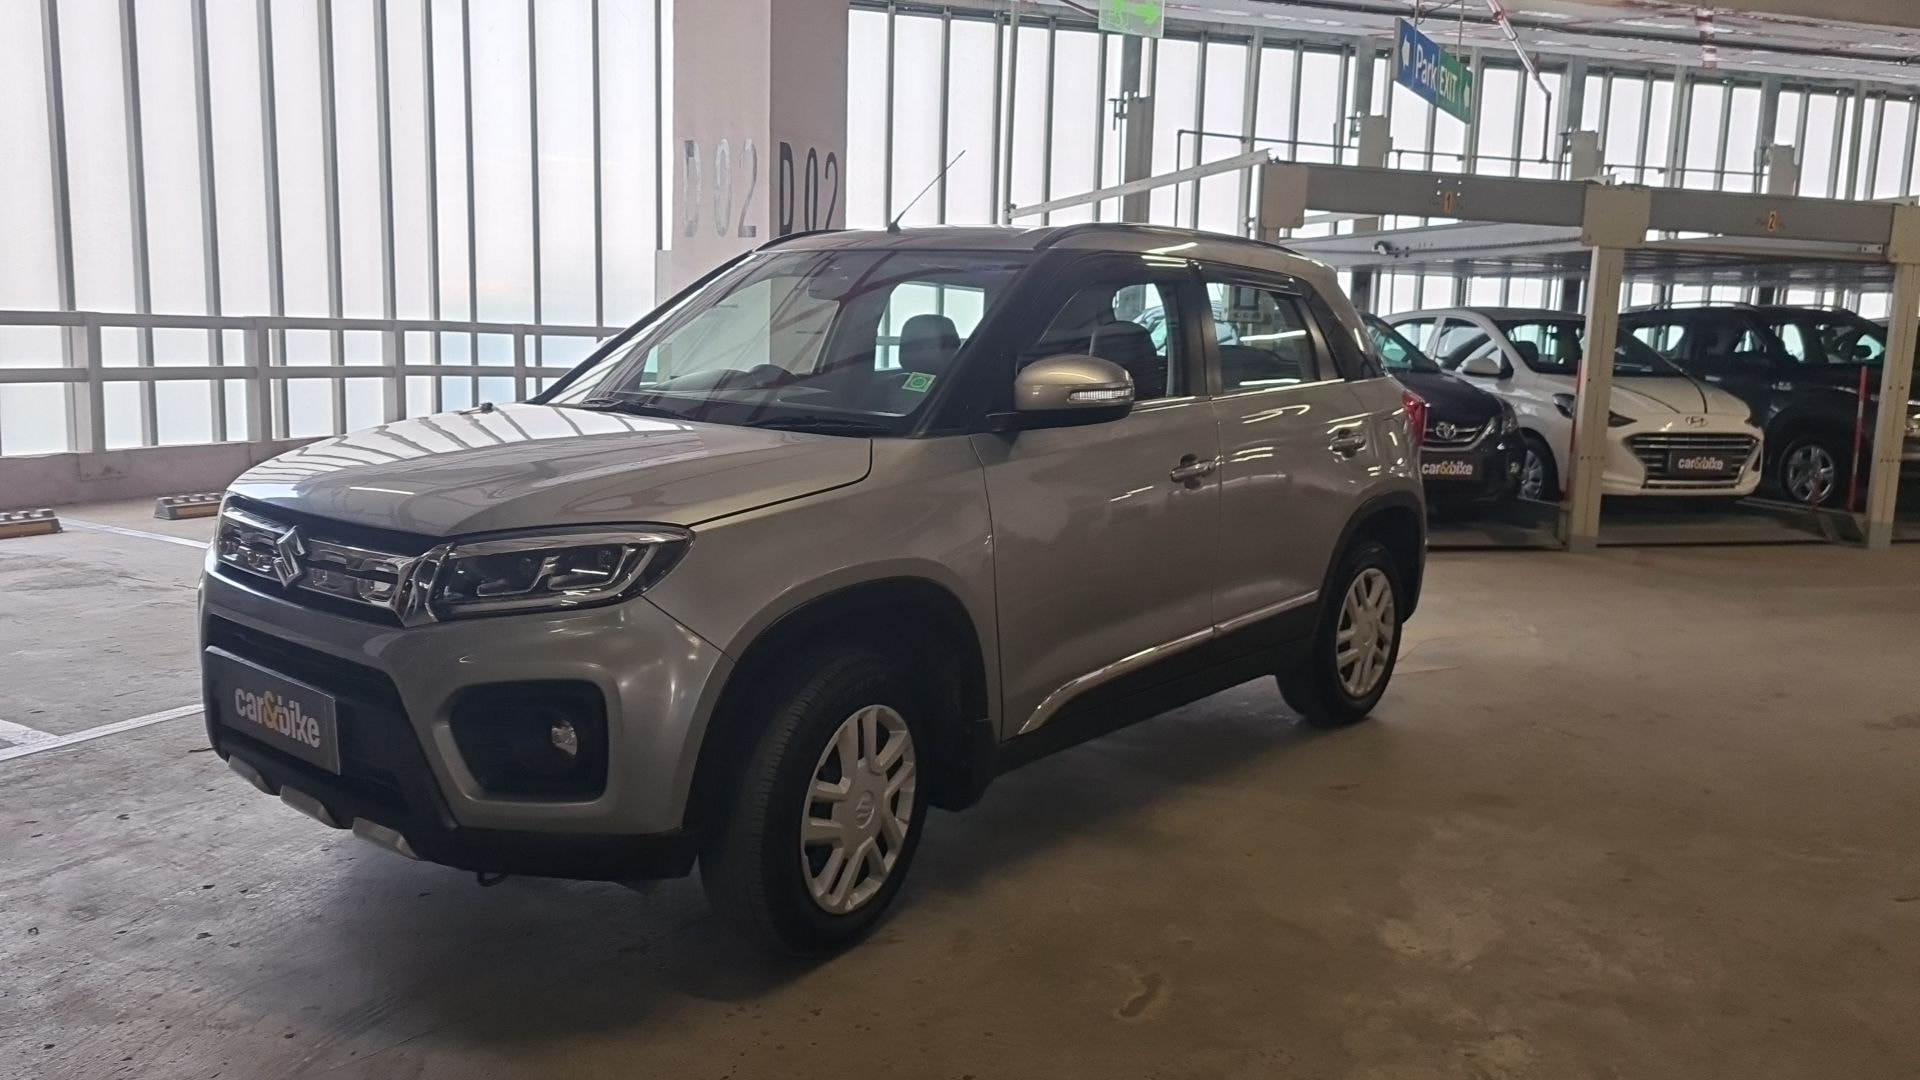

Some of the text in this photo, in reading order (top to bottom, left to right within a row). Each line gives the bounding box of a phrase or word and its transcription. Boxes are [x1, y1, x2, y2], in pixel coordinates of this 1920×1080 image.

[1415, 43, 1458, 103] Park EXIT
[684, 138, 758, 238] D02
[779, 141, 838, 236] D02
[1421, 460, 1473, 476] car&bike
[1678, 456, 1724, 471] car&bike
[234, 687, 320, 748] car&bike
